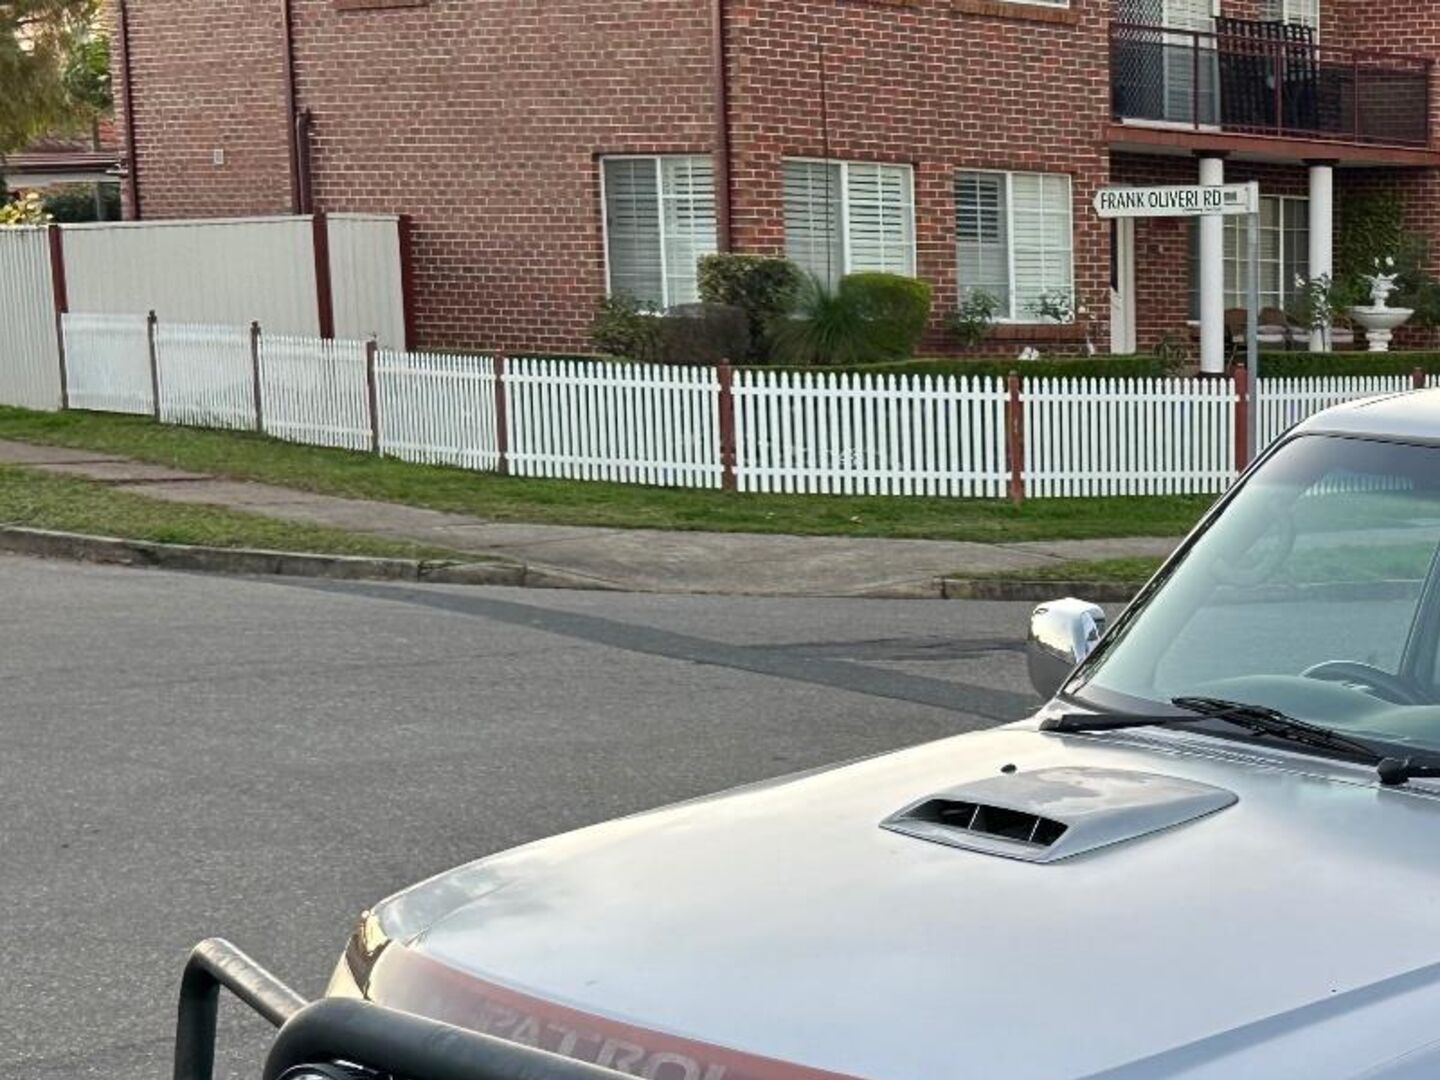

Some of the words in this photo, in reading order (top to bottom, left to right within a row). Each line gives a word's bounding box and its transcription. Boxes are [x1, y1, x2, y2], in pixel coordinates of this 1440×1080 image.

[1100, 192, 1145, 209] FRANK
[1148, 190, 1199, 208] OLIVERI
[1203, 189, 1222, 207] RD
